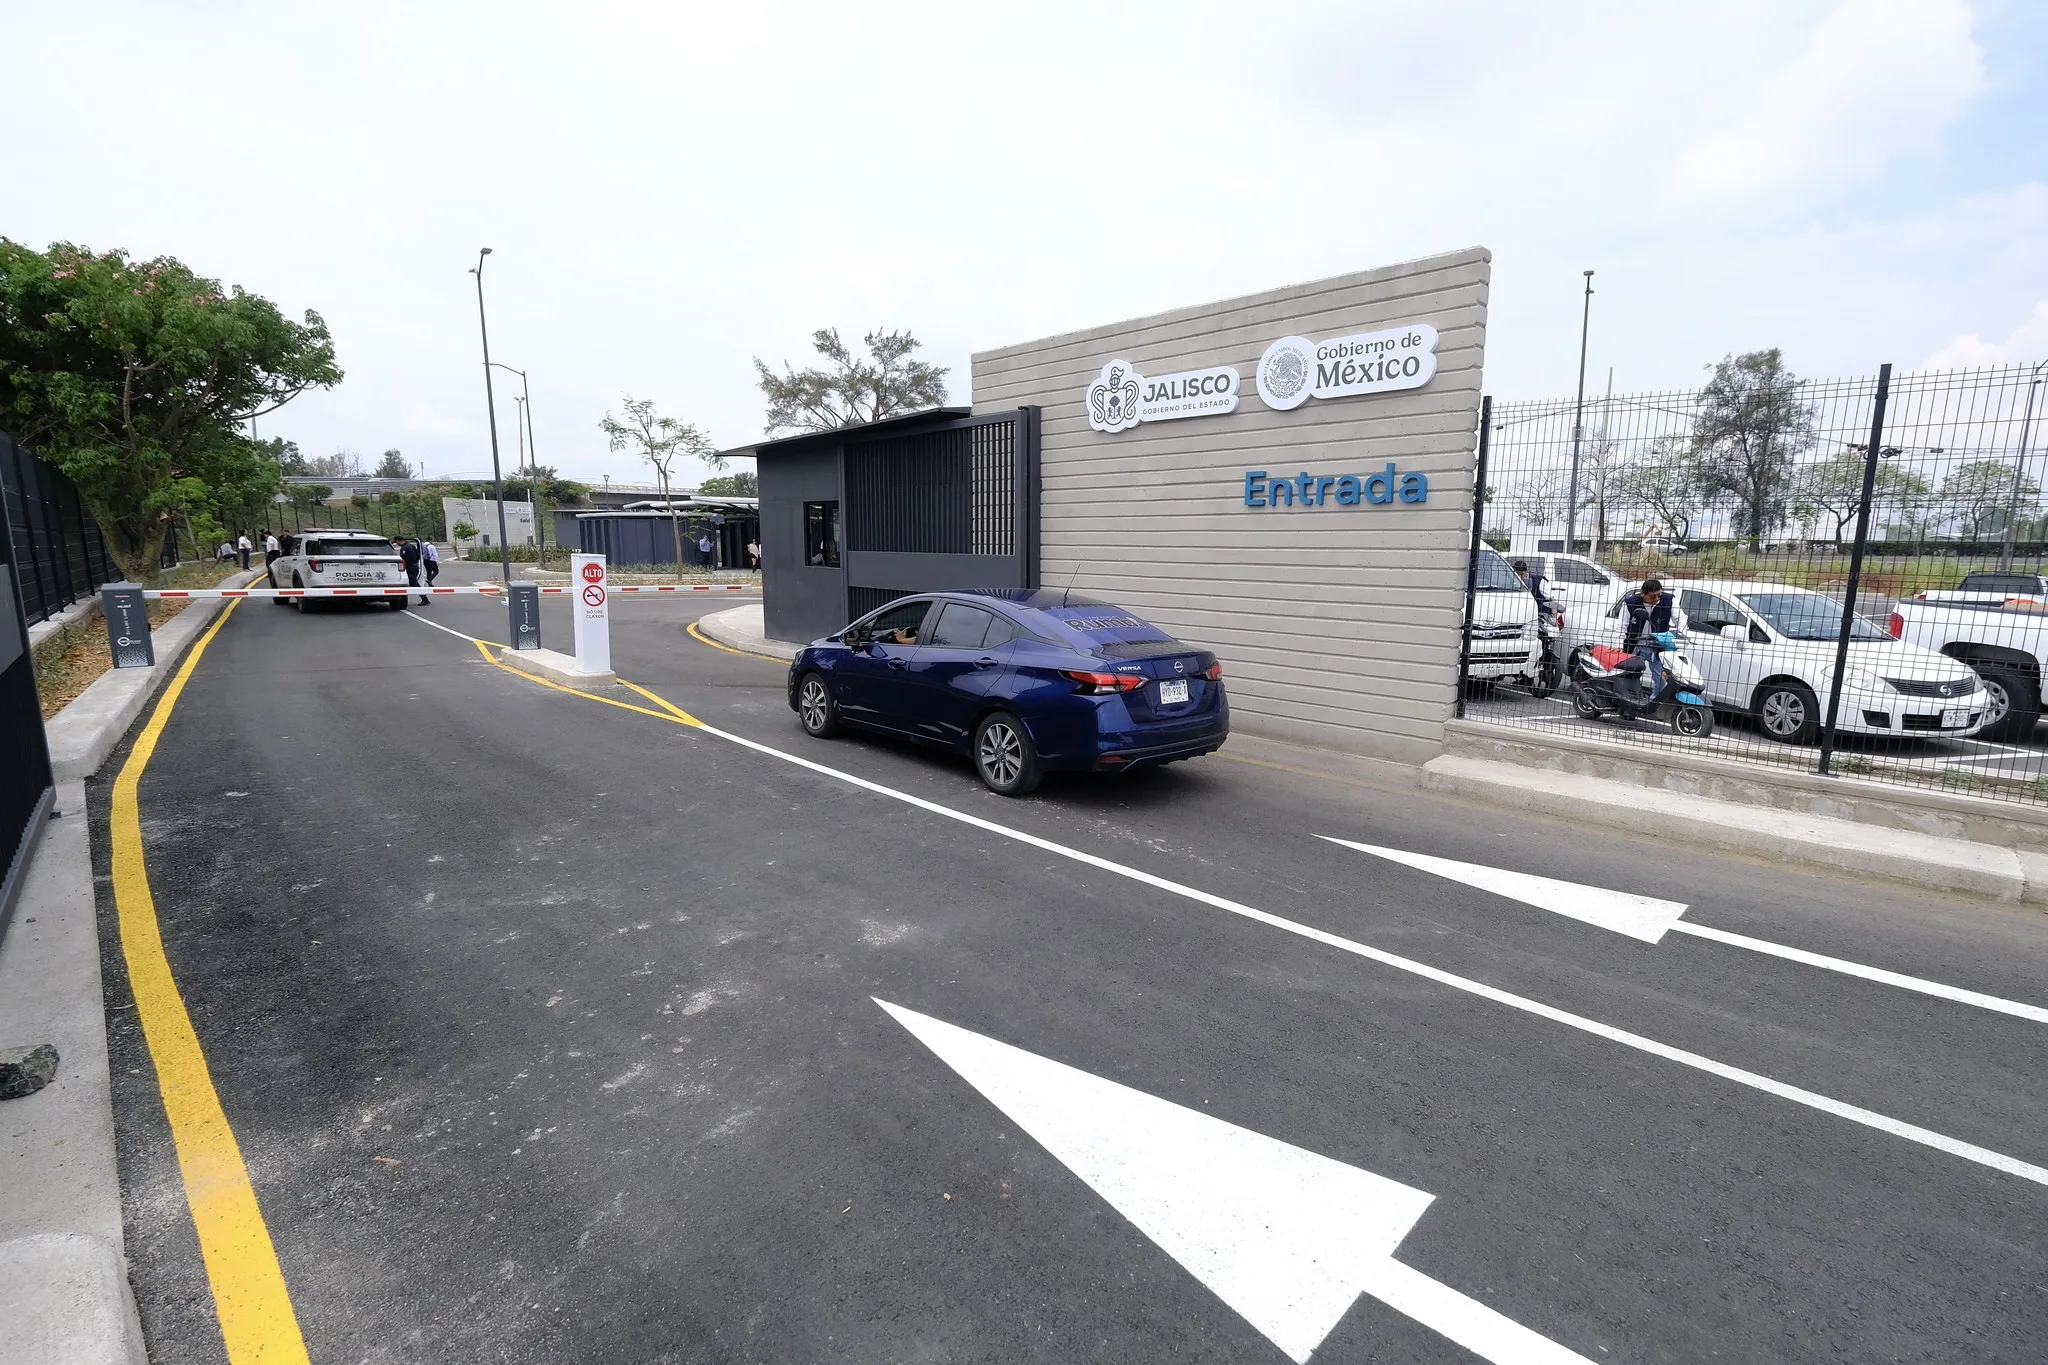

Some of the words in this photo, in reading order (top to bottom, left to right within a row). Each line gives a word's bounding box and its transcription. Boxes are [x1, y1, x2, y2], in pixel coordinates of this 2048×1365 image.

[1316, 339, 1396, 361] Gobierno
[1400, 332, 1422, 348] de
[1315, 353, 1420, 390] México
[1142, 373, 1231, 403] JALISCO
[1142, 404, 1180, 415] GOBIERNO
[1182, 402, 1197, 410] DEL
[1199, 398, 1230, 409] ESTADO
[1244, 462, 1429, 507] Entrada
[584, 568, 602, 578] ALTO
